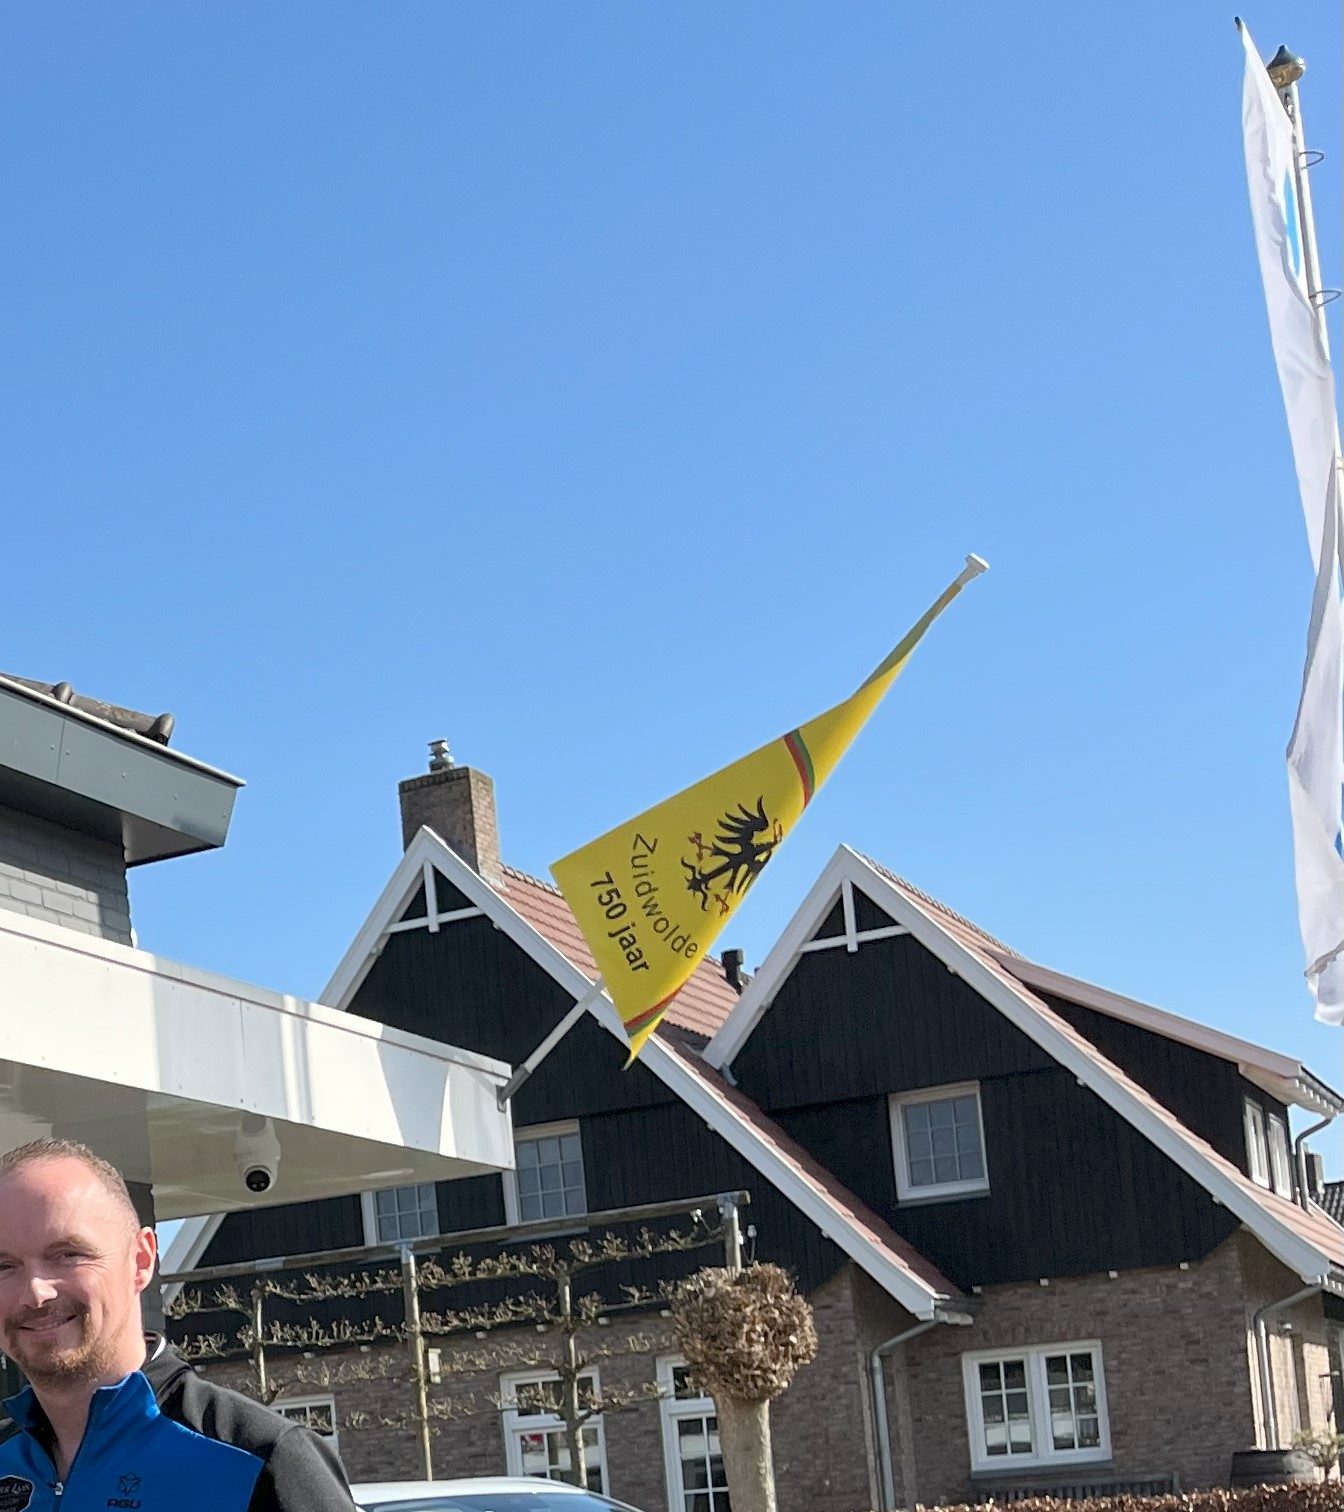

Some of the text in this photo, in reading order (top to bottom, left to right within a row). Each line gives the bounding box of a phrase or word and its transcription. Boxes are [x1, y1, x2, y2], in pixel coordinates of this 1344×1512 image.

[590, 872, 649, 971] 750 jaar
[631, 834, 698, 959] Zuidwolde
[107, 1498, 141, 1509] AGU
